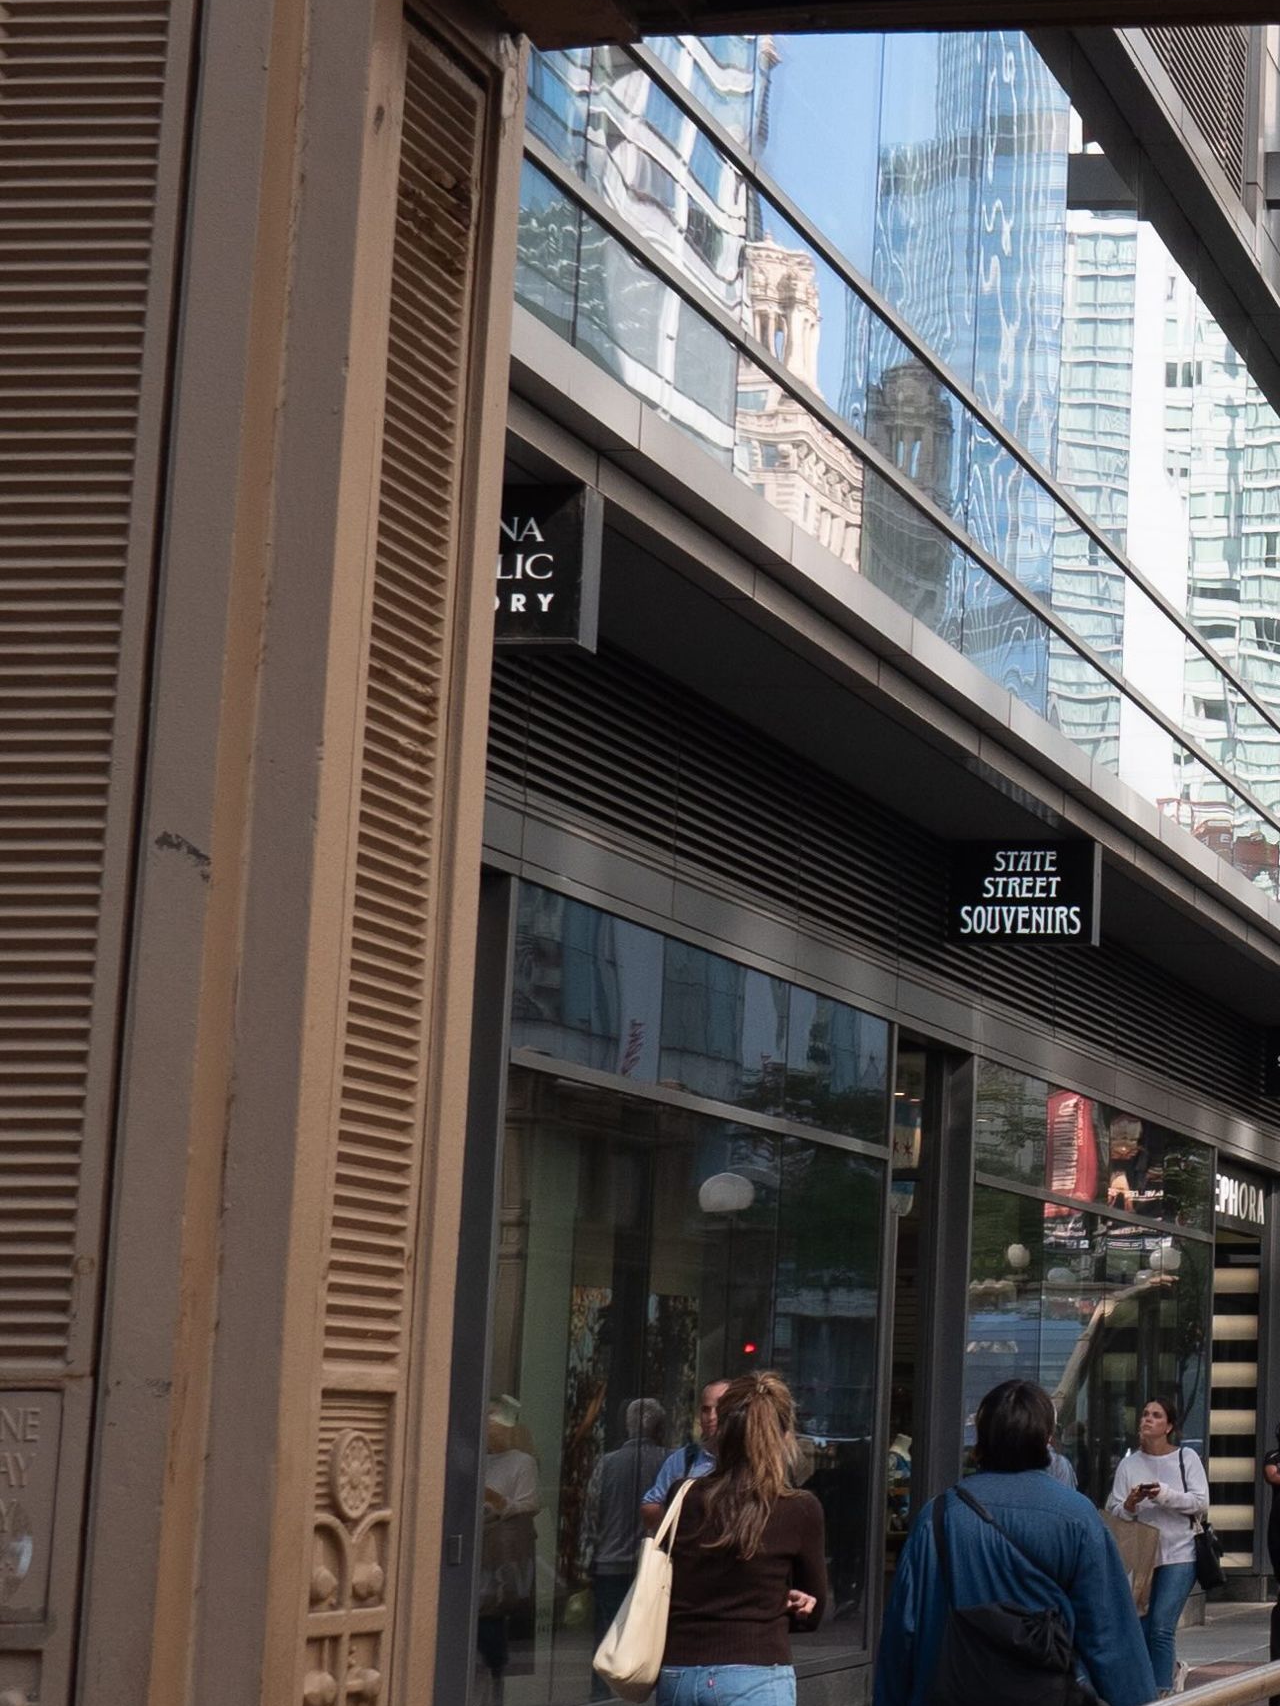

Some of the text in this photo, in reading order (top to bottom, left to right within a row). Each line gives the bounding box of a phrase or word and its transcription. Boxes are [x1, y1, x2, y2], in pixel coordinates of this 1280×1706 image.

[993, 850, 1058, 872] STATE
[982, 876, 1062, 899] STREET
[960, 905, 1082, 935] SOUVENIRS
